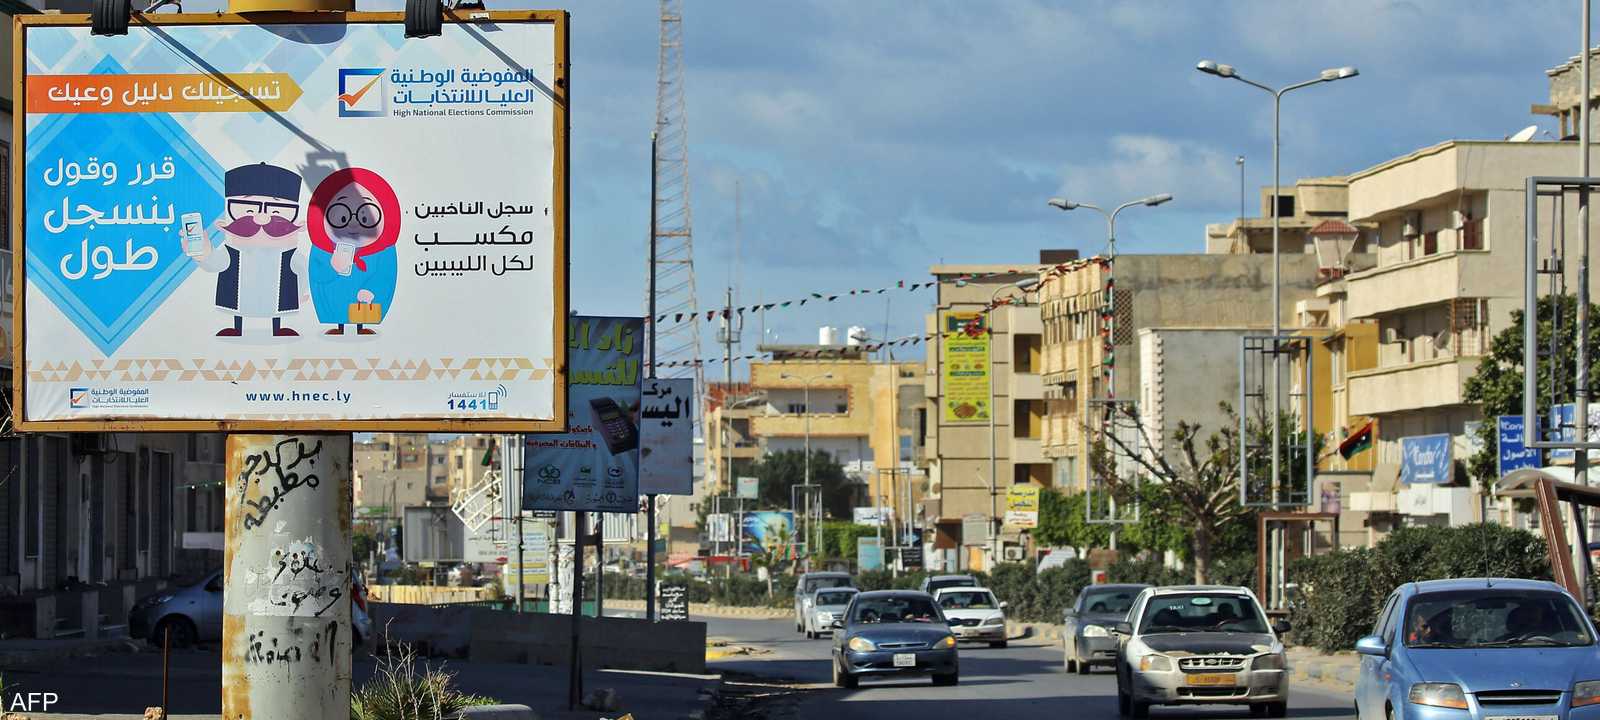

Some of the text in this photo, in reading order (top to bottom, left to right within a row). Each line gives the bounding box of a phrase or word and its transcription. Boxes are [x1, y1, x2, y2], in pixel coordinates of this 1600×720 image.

[391, 69, 534, 88] المفوضية الوطنية
[48, 81, 281, 106] تسجيلك دليل وعيك
[393, 89, 534, 107] العليا للانتخابات
[393, 109, 412, 117] High
[43, 156, 176, 187] قرر وقول
[43, 195, 175, 233] بنسجل
[415, 202, 534, 218] سجل الناخبين
[414, 226, 534, 252] مكسب
[60, 238, 159, 280] طول
[414, 255, 534, 277] لكل الليبيين
[246, 391, 351, 404] www.hnec.ly
[643, 382, 672, 399] مرك
[447, 399, 487, 410] 1441
[642, 395, 690, 428] اليس
